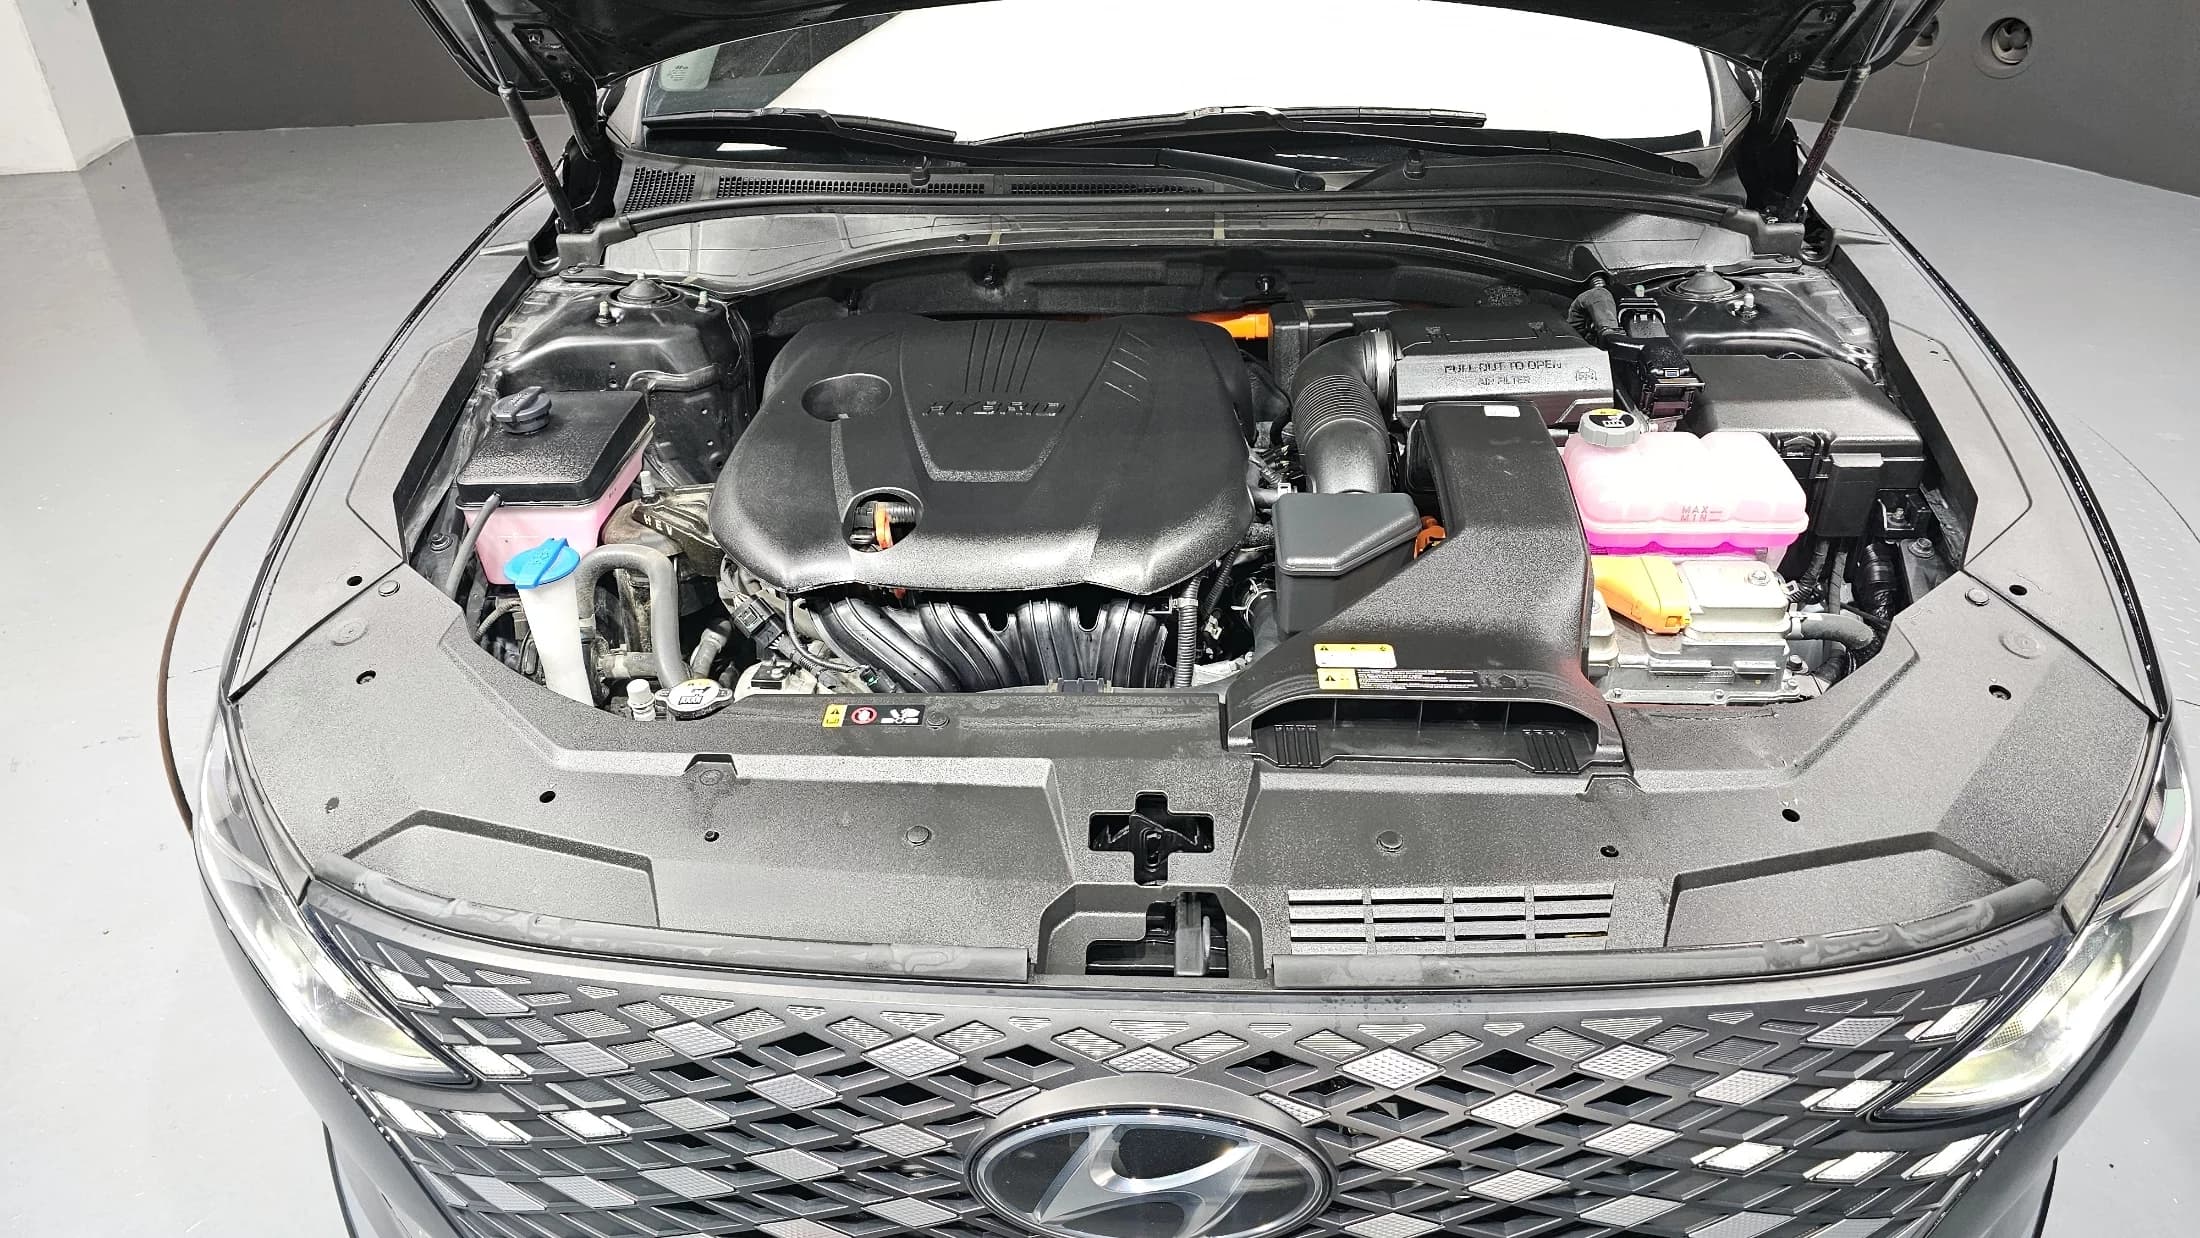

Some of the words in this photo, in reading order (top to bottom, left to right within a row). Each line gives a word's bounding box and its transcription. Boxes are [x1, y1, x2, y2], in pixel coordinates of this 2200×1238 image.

[1444, 363, 1476, 374] PULL
[1478, 361, 1503, 373] OUT
[1509, 361, 1524, 371] TO
[1527, 359, 1562, 370] OPEN
[1497, 375, 1531, 386] FILTER
[1682, 504, 1708, 514] MAX
[1681, 514, 1707, 522] MIN
[643, 514, 673, 536] HEV
